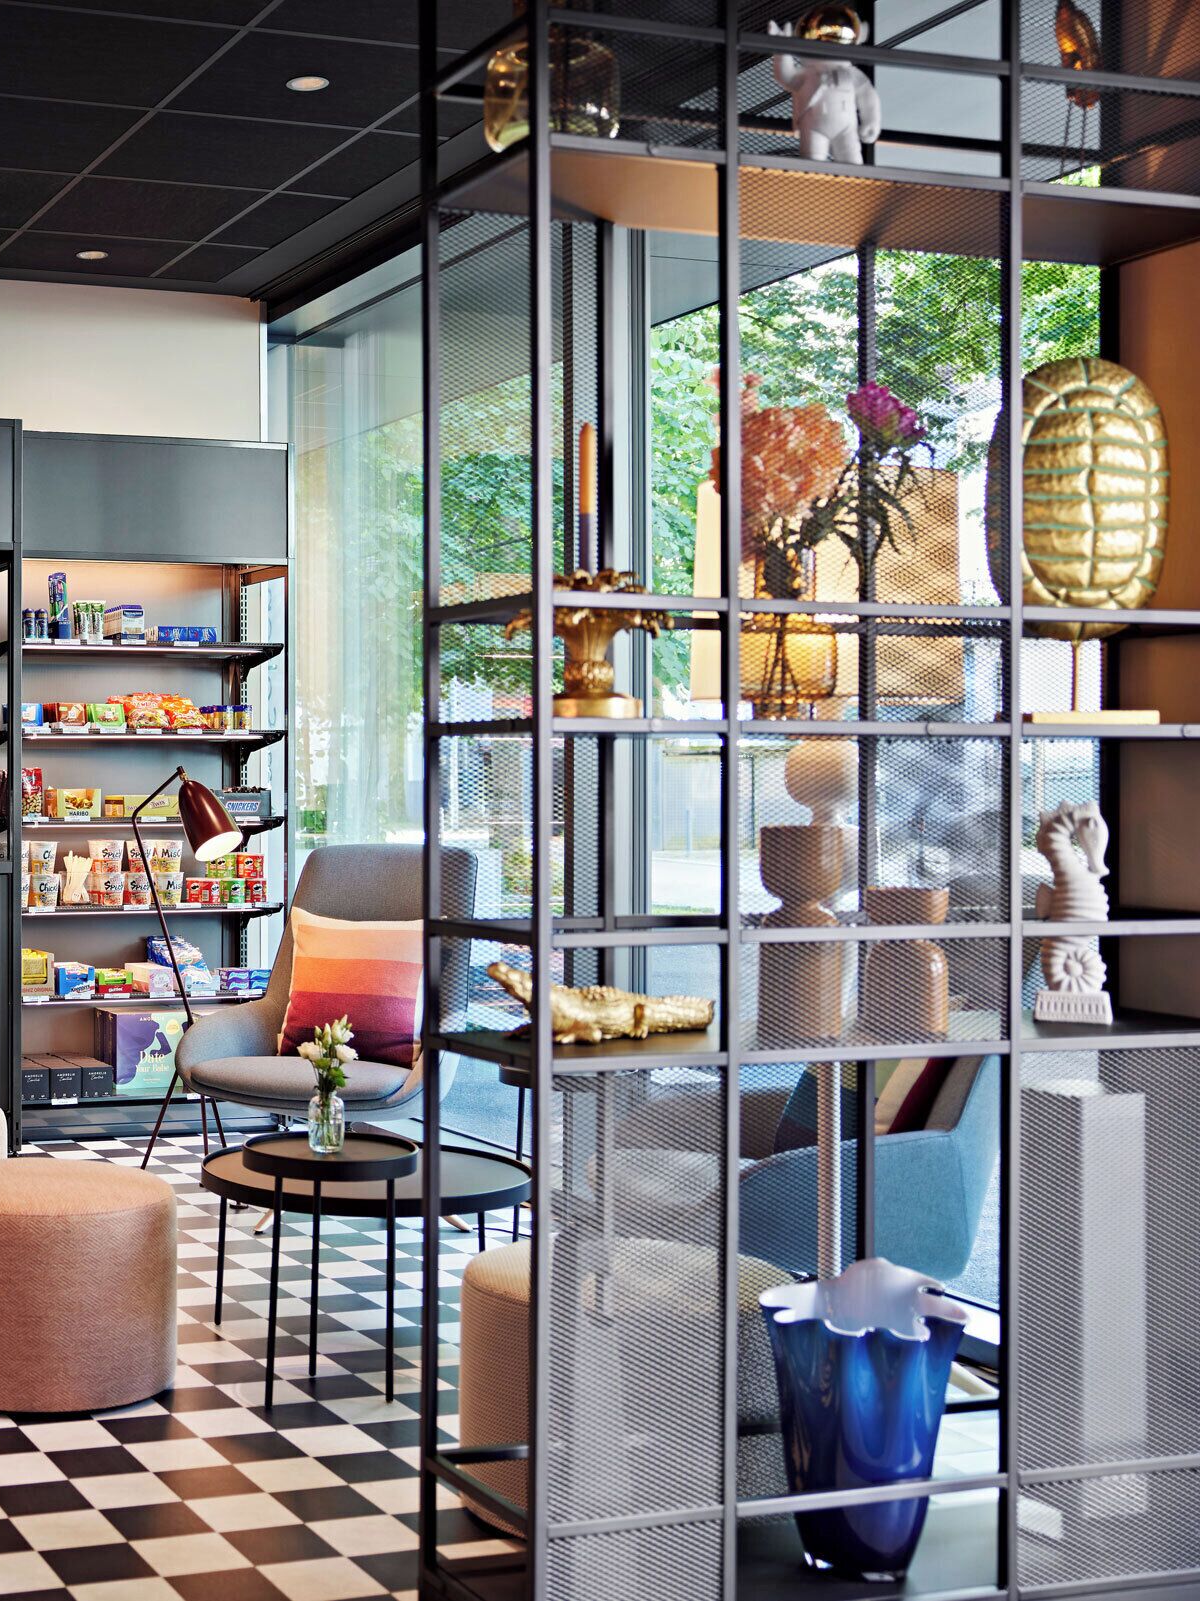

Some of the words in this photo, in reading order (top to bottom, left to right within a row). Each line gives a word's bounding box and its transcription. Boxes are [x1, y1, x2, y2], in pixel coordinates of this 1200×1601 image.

[226, 801, 260, 812] SNICKERS
[130, 848, 152, 858] Spiy
[140, 1050, 165, 1064] Date
